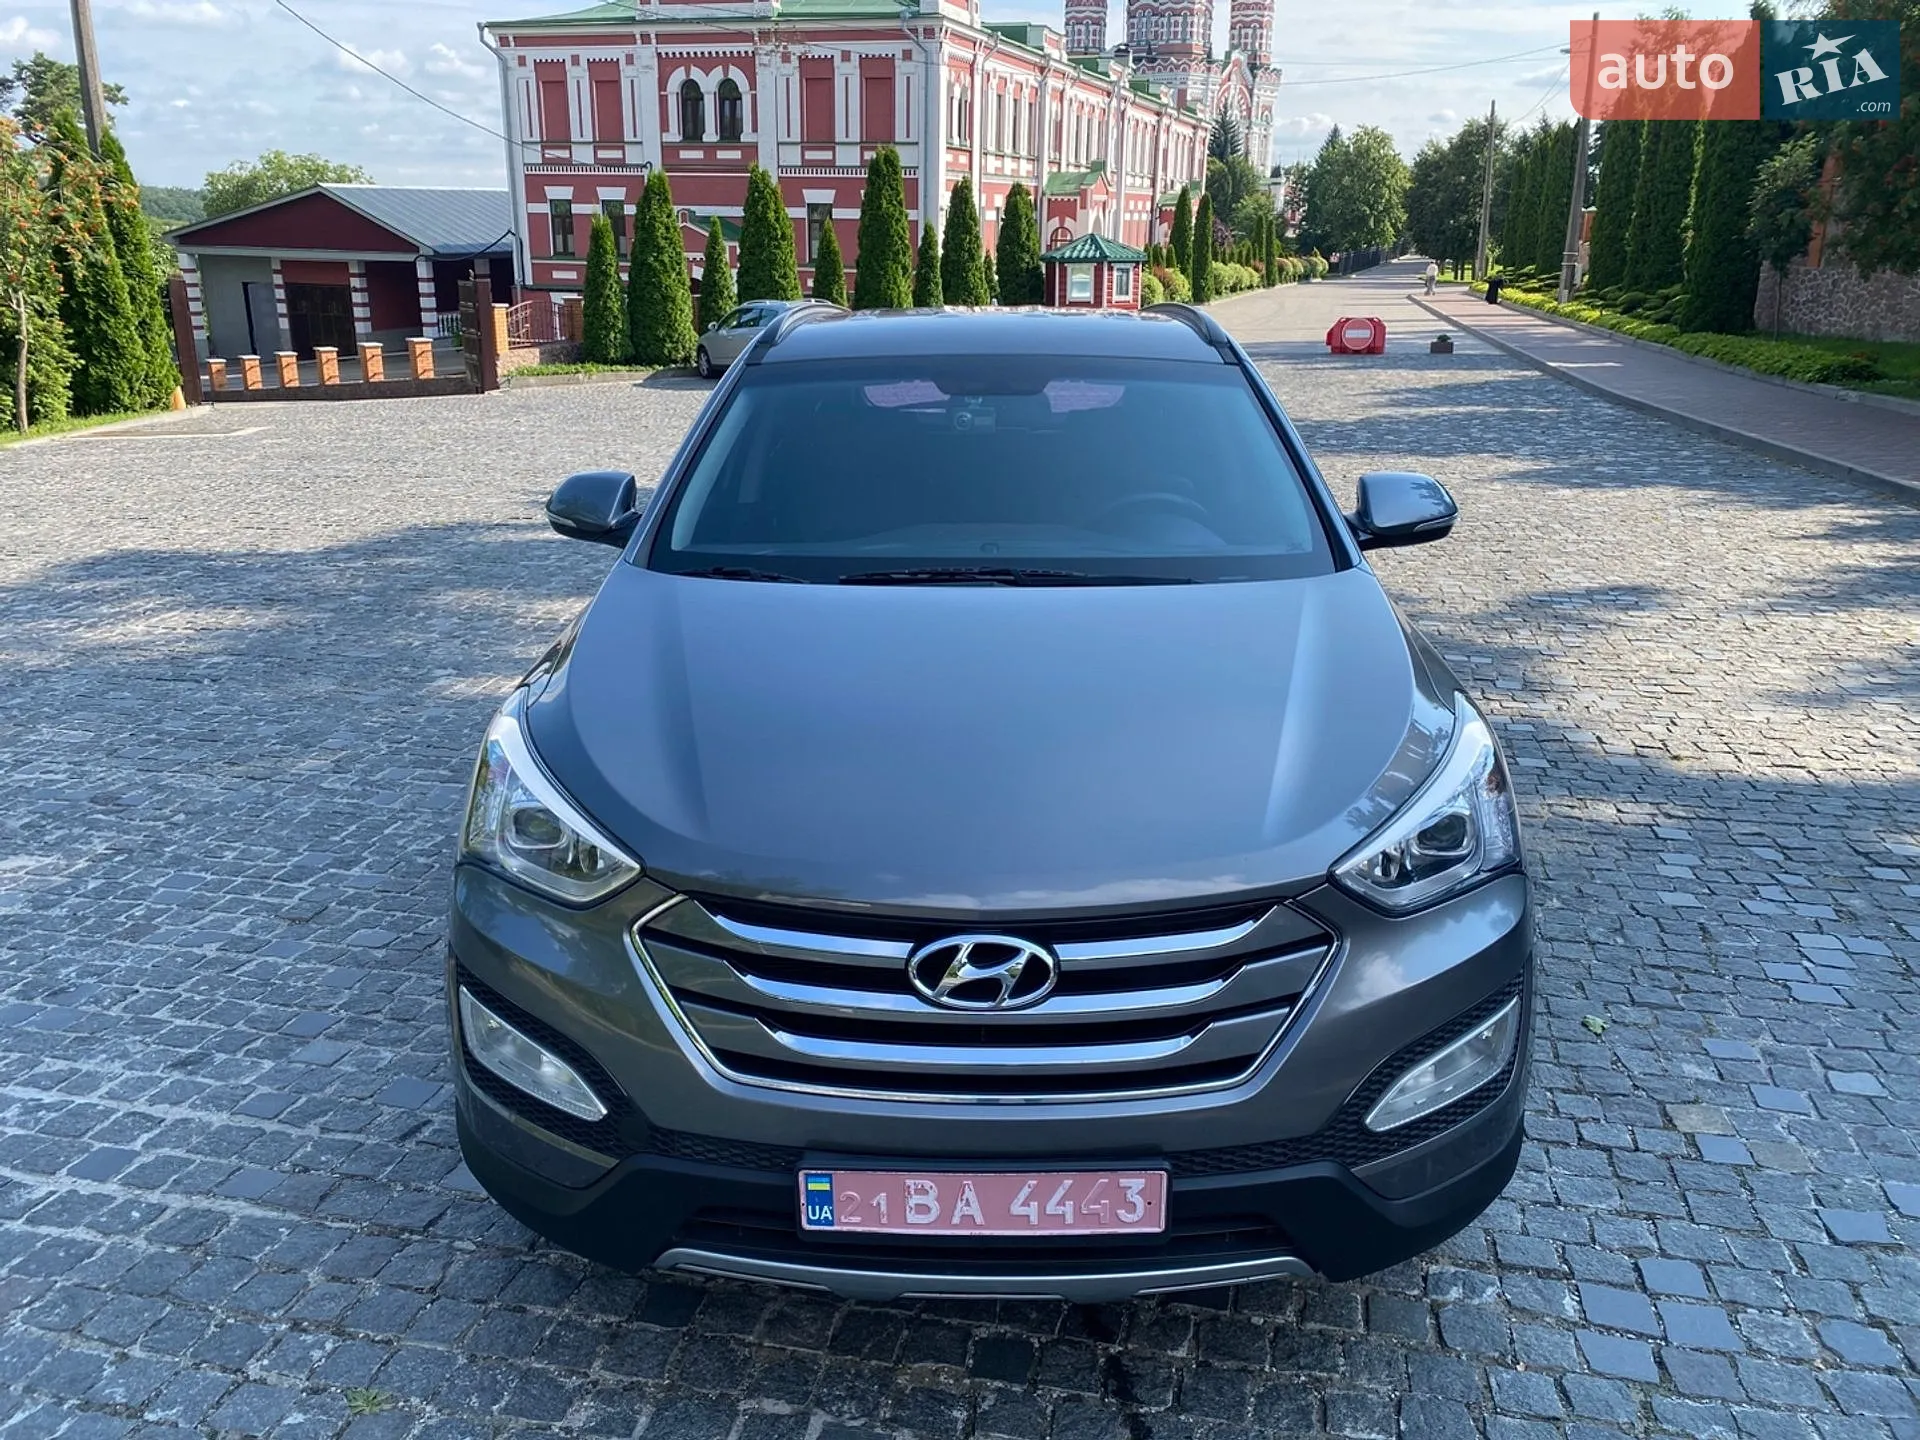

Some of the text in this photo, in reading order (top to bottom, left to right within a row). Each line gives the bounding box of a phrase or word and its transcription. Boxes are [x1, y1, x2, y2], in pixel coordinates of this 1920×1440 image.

[808, 1205, 833, 1221] UA
[904, 1179, 985, 1225] BA
[1009, 1178, 1147, 1225] 4443
